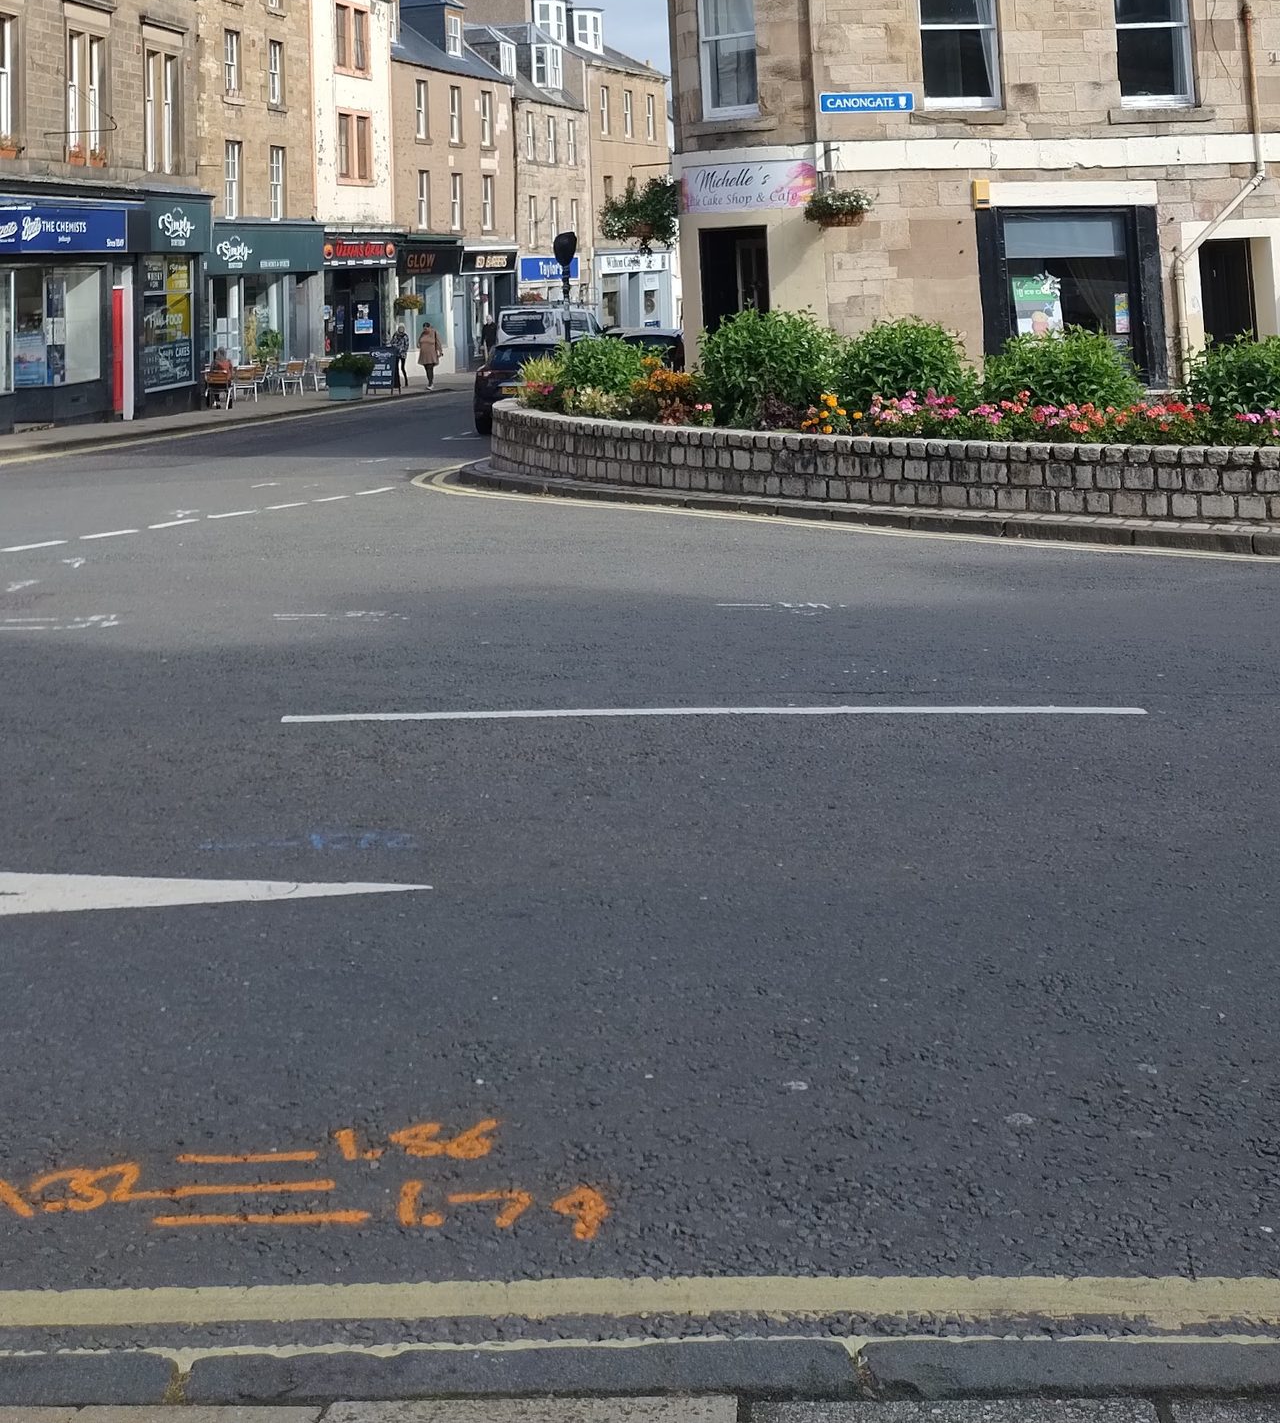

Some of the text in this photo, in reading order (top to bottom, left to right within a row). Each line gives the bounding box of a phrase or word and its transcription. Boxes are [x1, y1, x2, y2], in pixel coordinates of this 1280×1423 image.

[826, 97, 895, 108] CANONGATE
[702, 194, 723, 207] Cake
[726, 192, 752, 207] Shop
[756, 192, 764, 203] &
[21, 216, 87, 241] Boots THE CHEMISTS
[158, 212, 195, 238] Simply
[216, 241, 253, 262] Simply
[406, 253, 436, 269] GLOW
